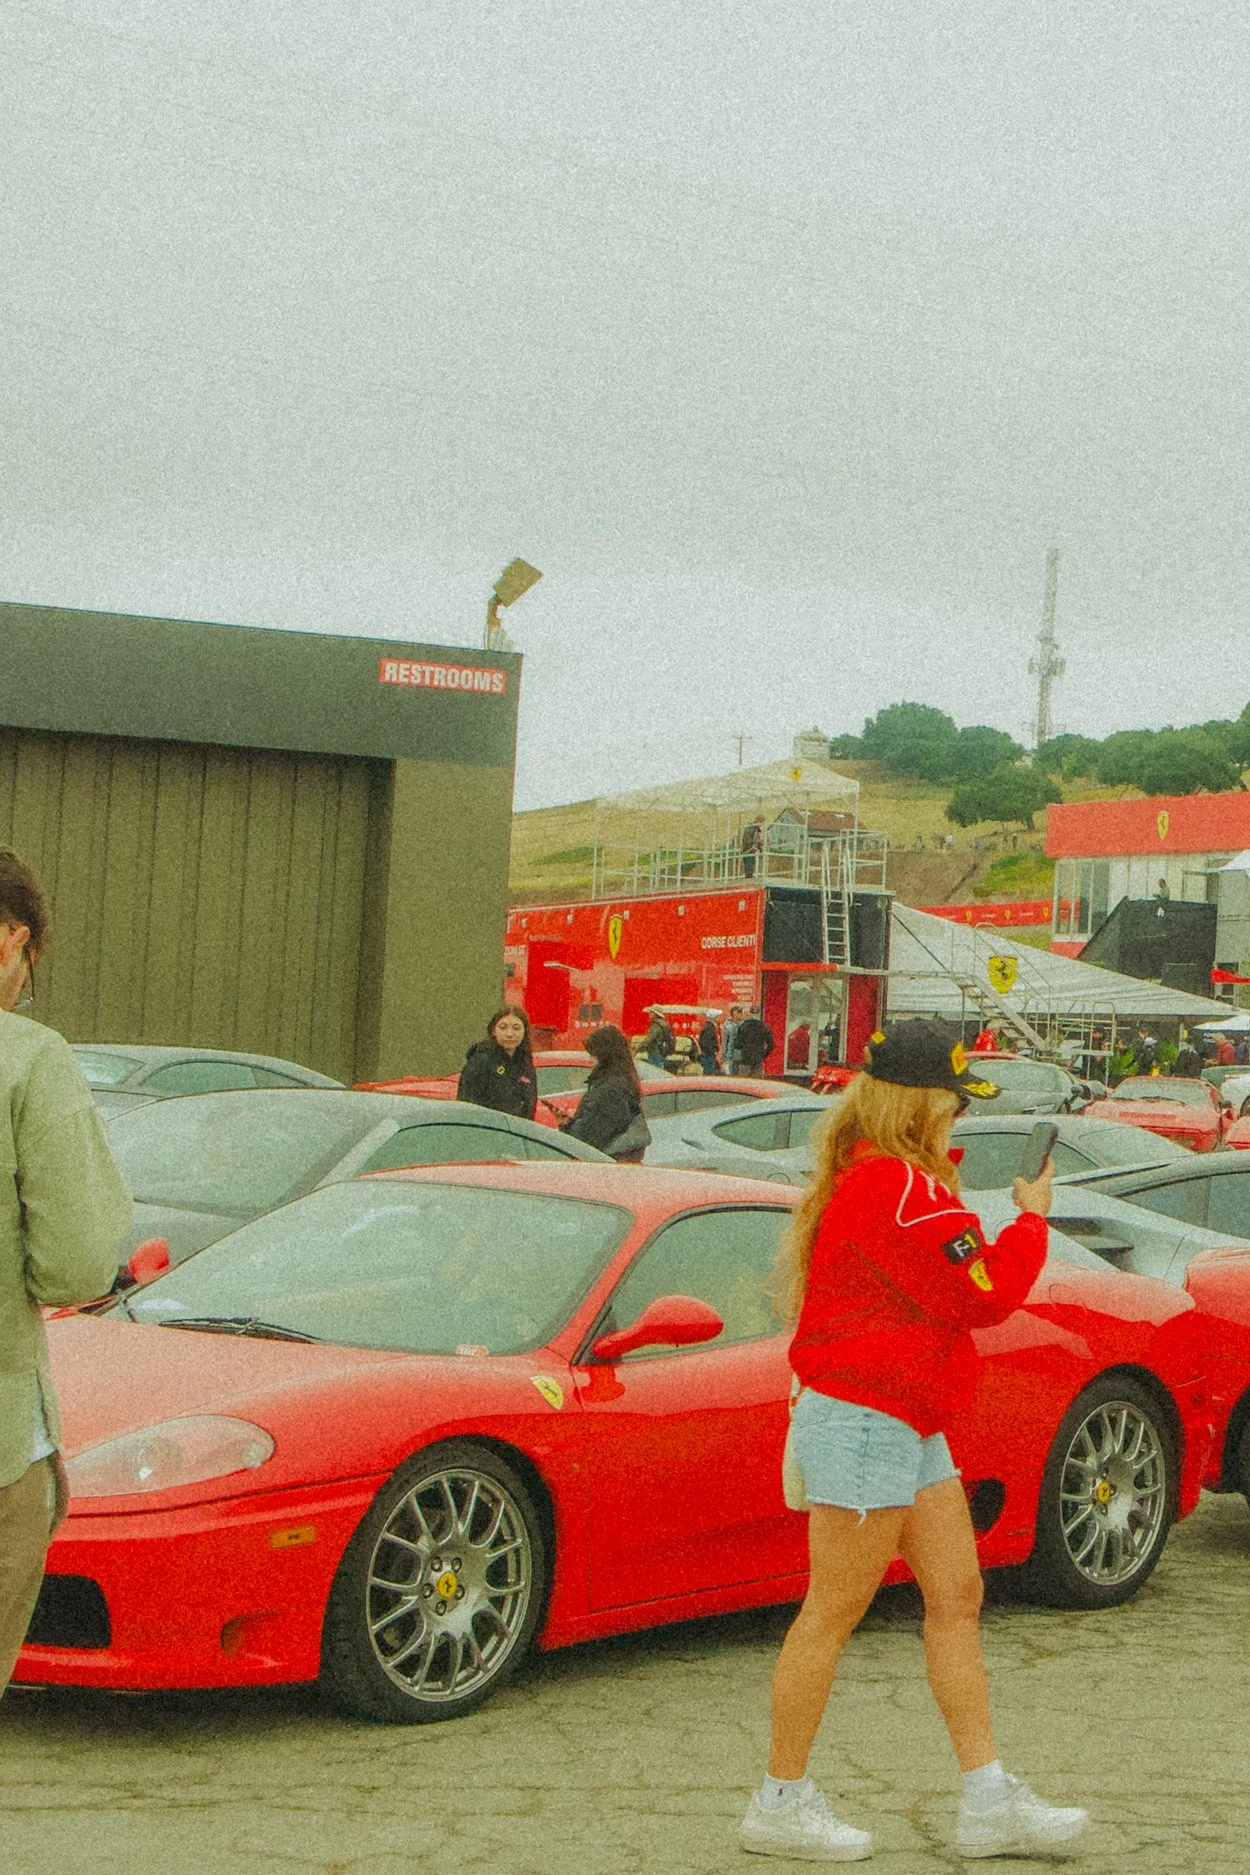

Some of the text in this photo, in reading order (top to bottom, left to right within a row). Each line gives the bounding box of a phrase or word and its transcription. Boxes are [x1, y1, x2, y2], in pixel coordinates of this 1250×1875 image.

[384, 662, 504, 692] RESTROOMS
[701, 935, 726, 949] CORSE
[952, 1233, 978, 1257] F1
